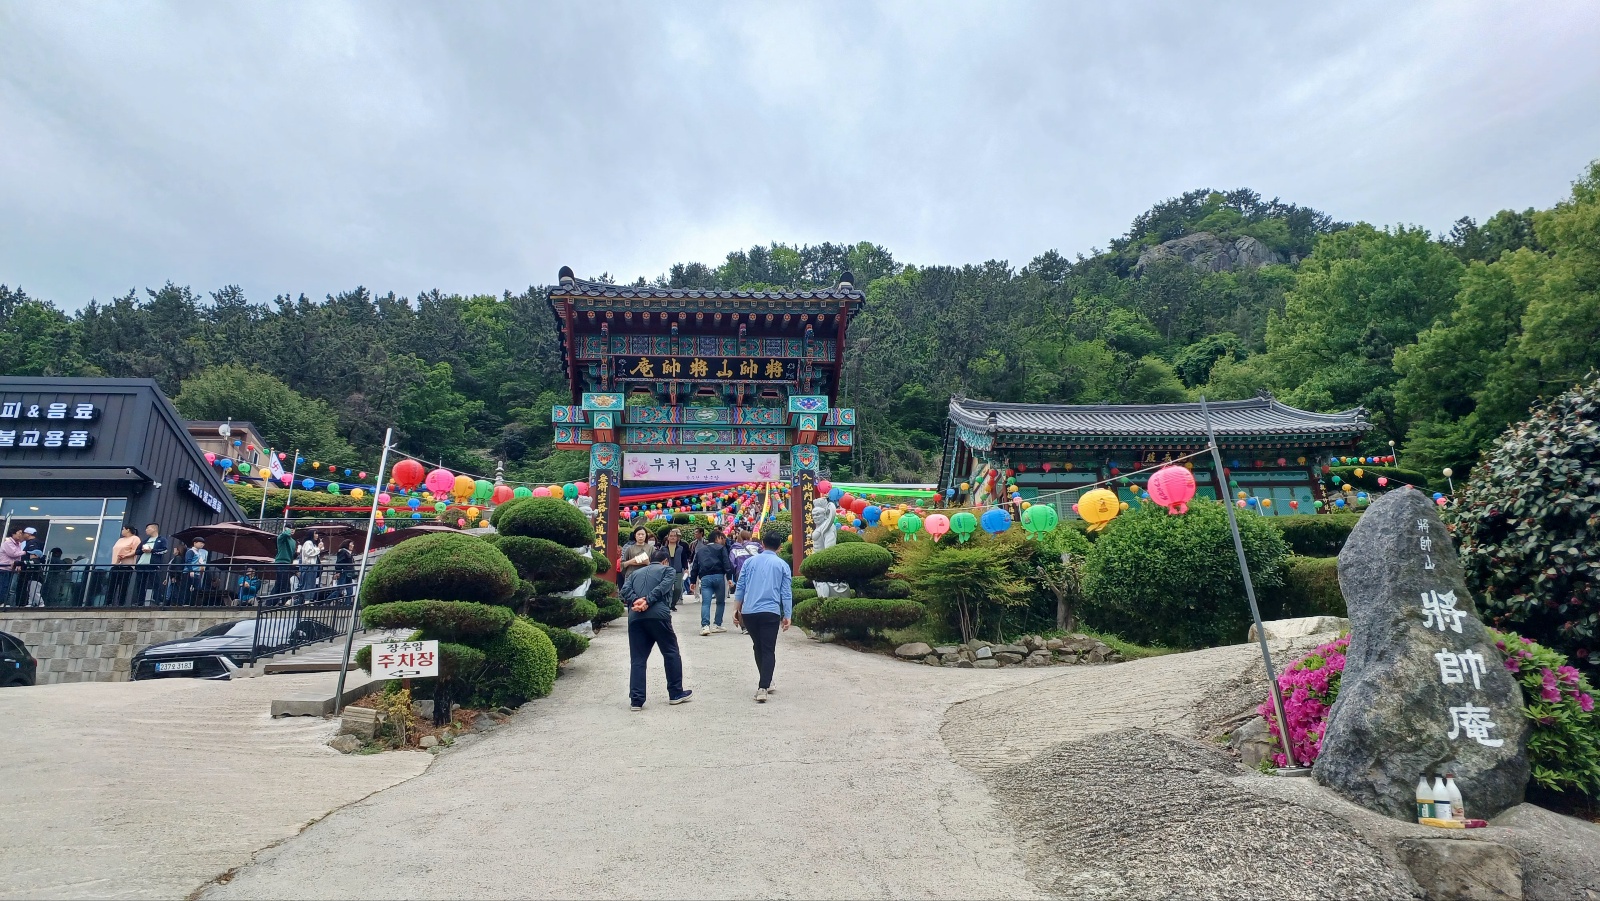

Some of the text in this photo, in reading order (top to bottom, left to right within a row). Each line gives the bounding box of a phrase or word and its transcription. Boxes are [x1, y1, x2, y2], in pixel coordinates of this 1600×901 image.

[27, 404, 40, 418] &
[47, 402, 94, 420] 음료
[0, 429, 89, 447] 불교용품
[650, 457, 756, 473] 부처님 오신날
[188, 480, 200, 497] 커피
[202, 490, 223, 513] 불교용품
[386, 641, 425, 654] 장수암
[176, 662, 192, 670] 3183
[377, 651, 435, 669] 주차장
[1420, 589, 1504, 748] 將帥庵
